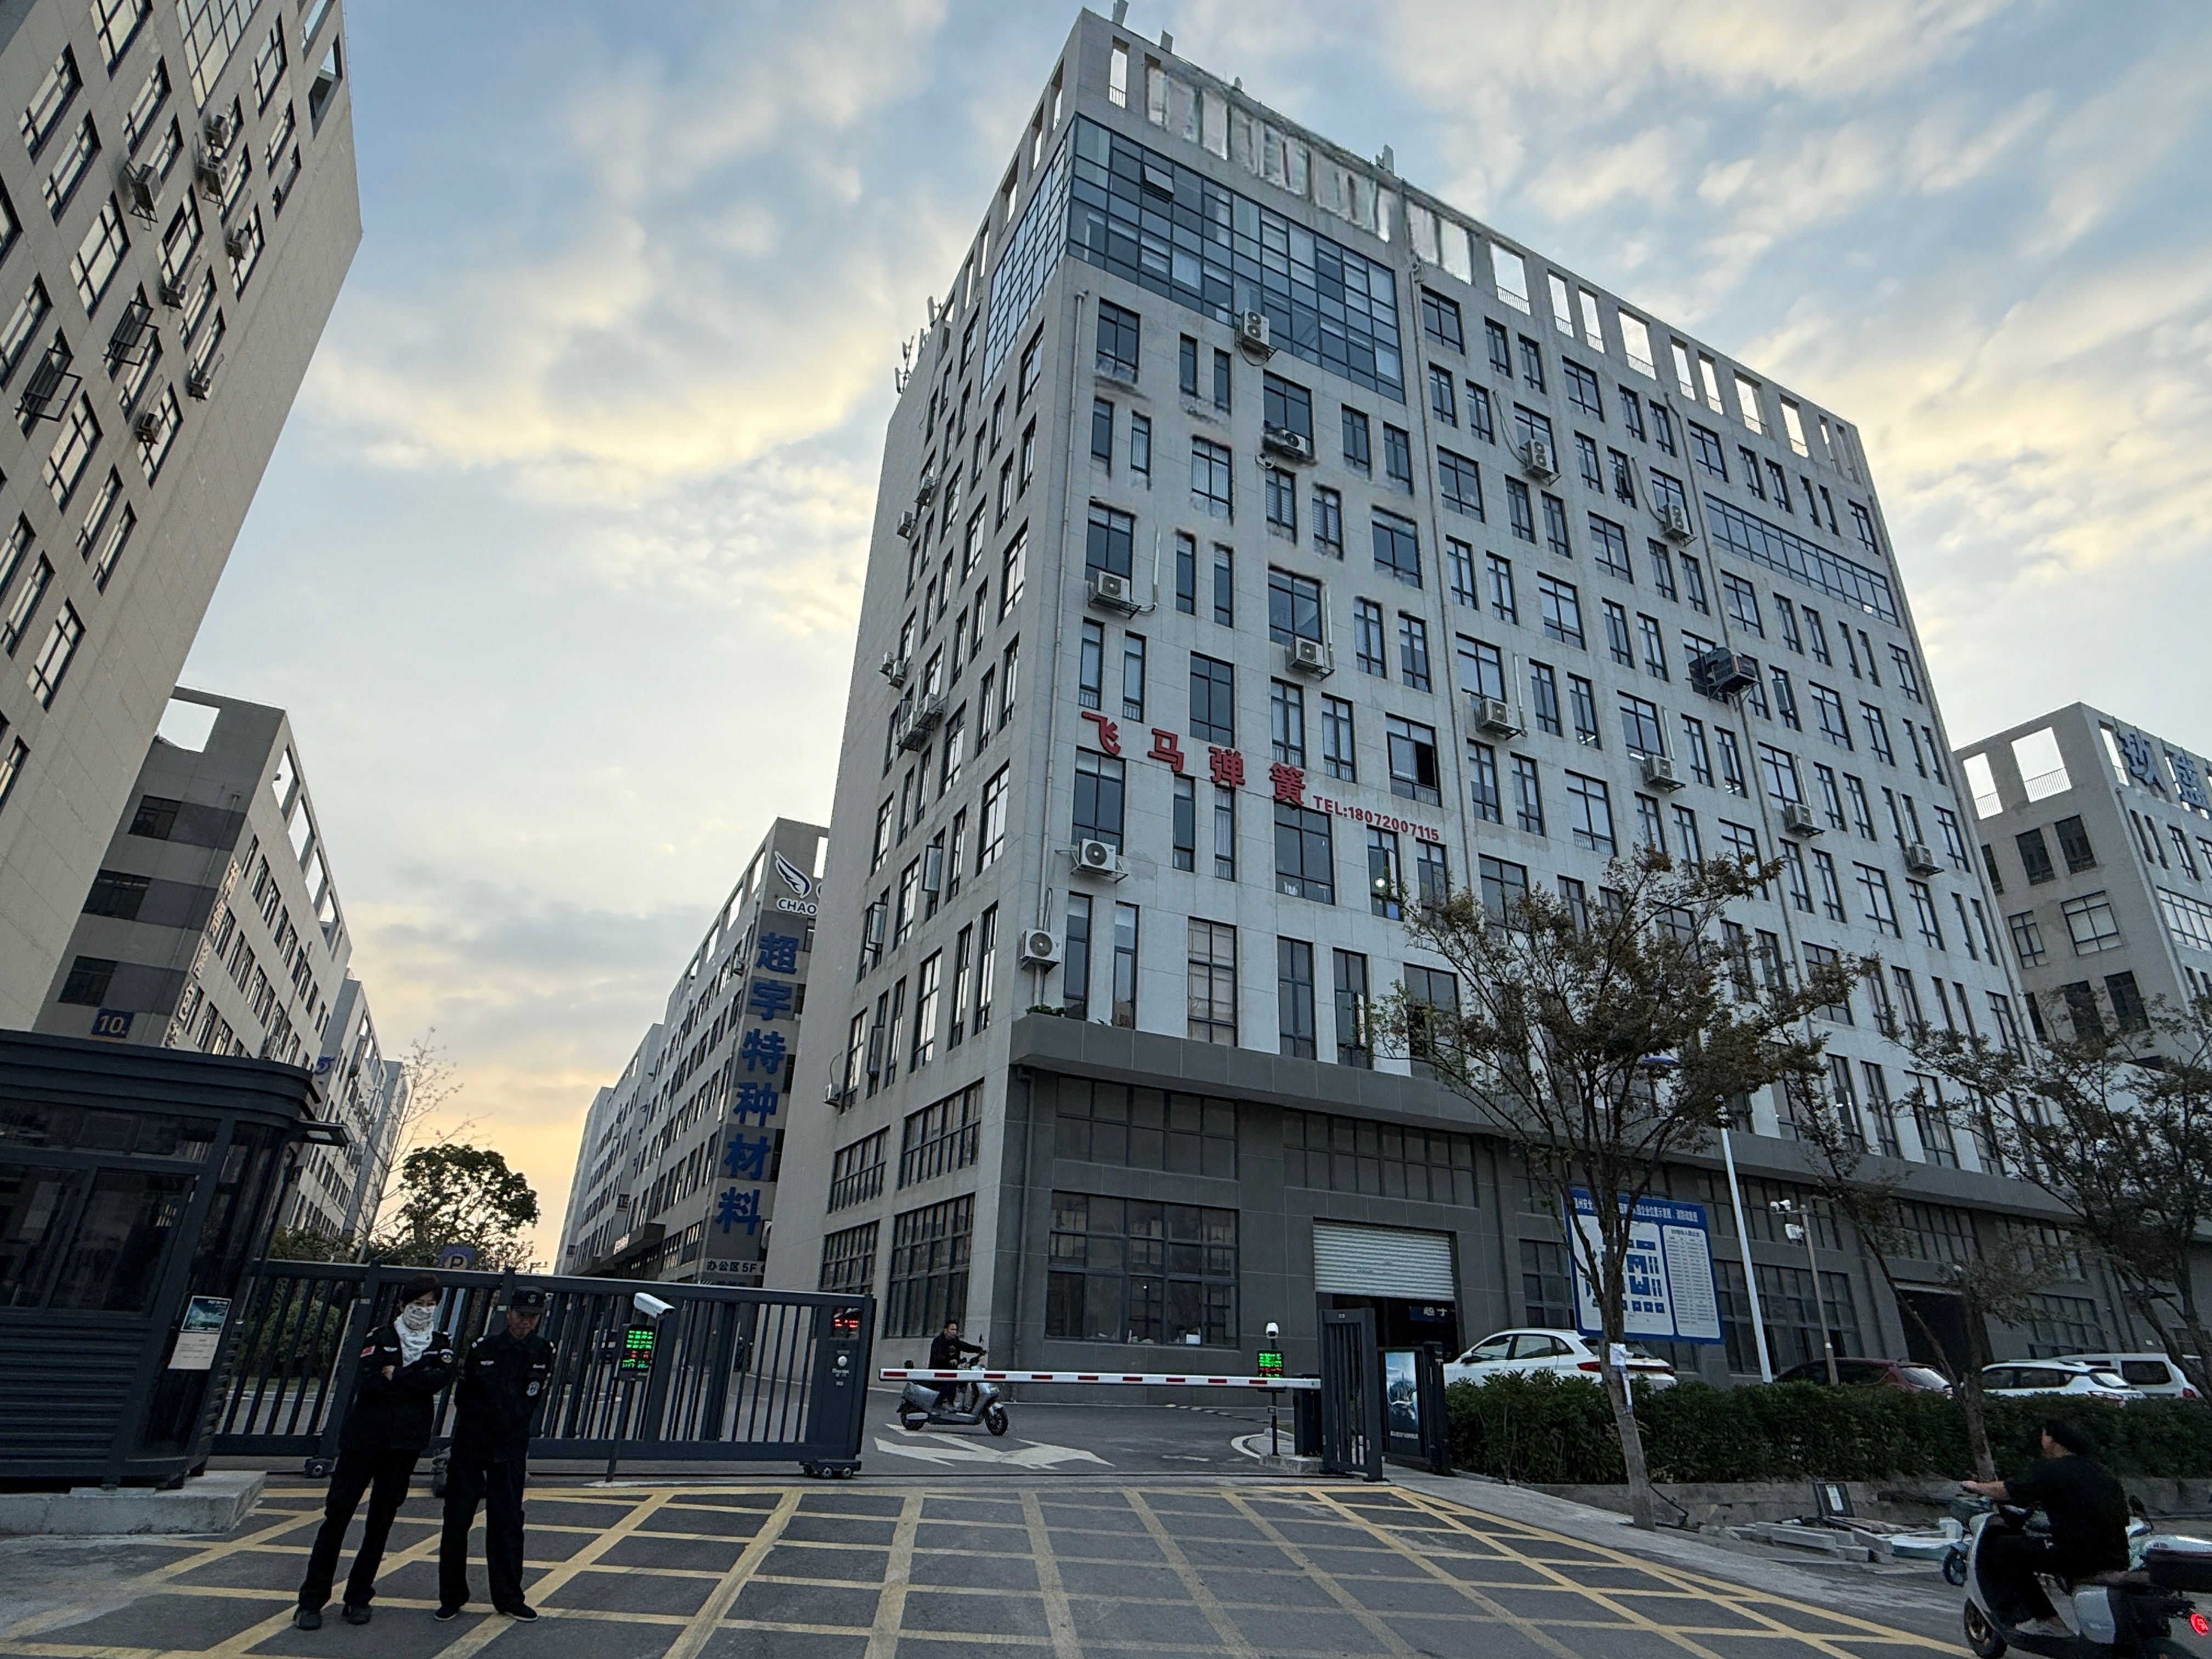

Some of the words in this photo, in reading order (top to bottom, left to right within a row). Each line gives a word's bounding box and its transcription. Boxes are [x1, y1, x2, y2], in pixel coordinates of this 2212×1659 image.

[1081, 710, 1306, 806] 飞马弹簧
[1312, 794, 1440, 842] TEL:18072007115
[777, 898, 818, 916] CHAO
[715, 931, 799, 1235] 超宇特种材料
[706, 1260, 740, 1272] 办公区
[742, 1262, 757, 1273] 5F
